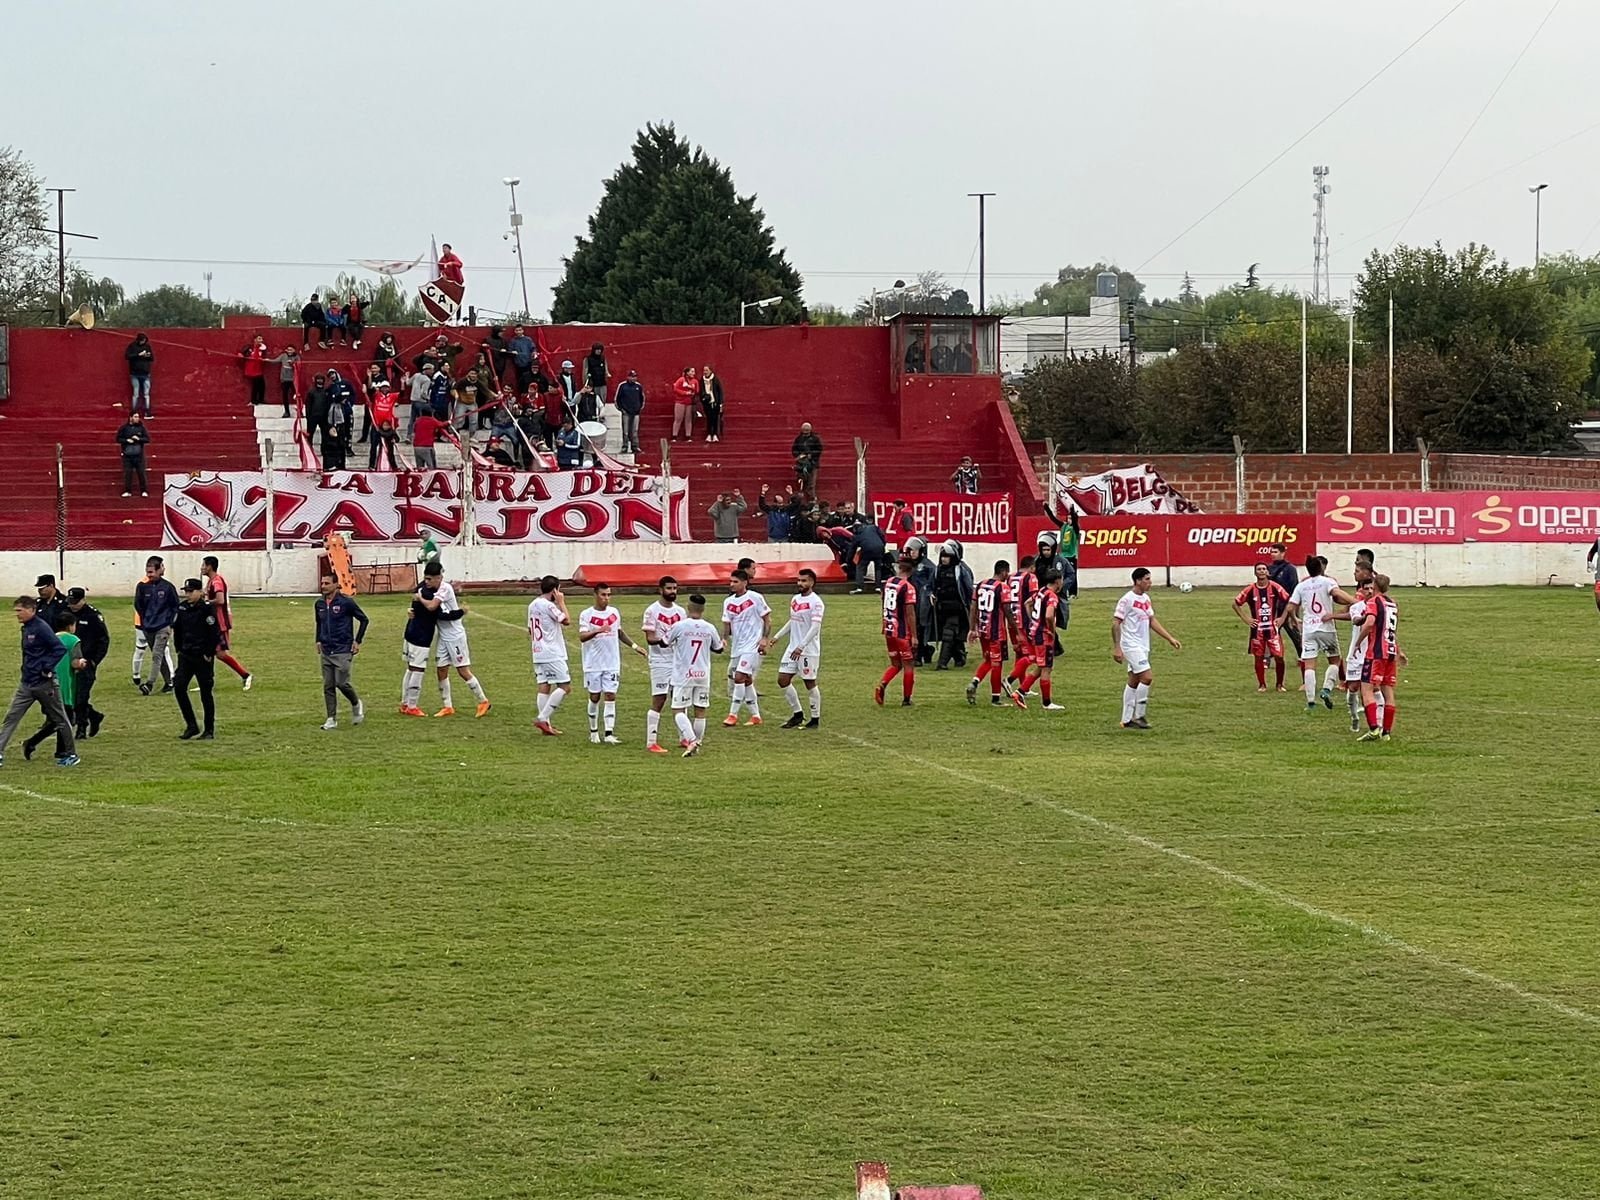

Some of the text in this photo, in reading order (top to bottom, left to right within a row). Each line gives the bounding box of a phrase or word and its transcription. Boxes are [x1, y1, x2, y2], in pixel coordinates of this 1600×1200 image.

[318, 471, 652, 501] LA BARRA DEL
[240, 485, 686, 541] ZANJON
[913, 501, 1009, 535] BELGRANO
[1371, 506, 1456, 535] open
[1518, 506, 1600, 535] open
[1187, 524, 1298, 547] opensports
[1399, 528, 1456, 536] SPORTS
[1547, 527, 1600, 535] SPORTS
[1105, 547, 1138, 556] .com.ar
[978, 587, 995, 612] 20
[1311, 592, 1323, 614] 6
[691, 639, 703, 665] 7
